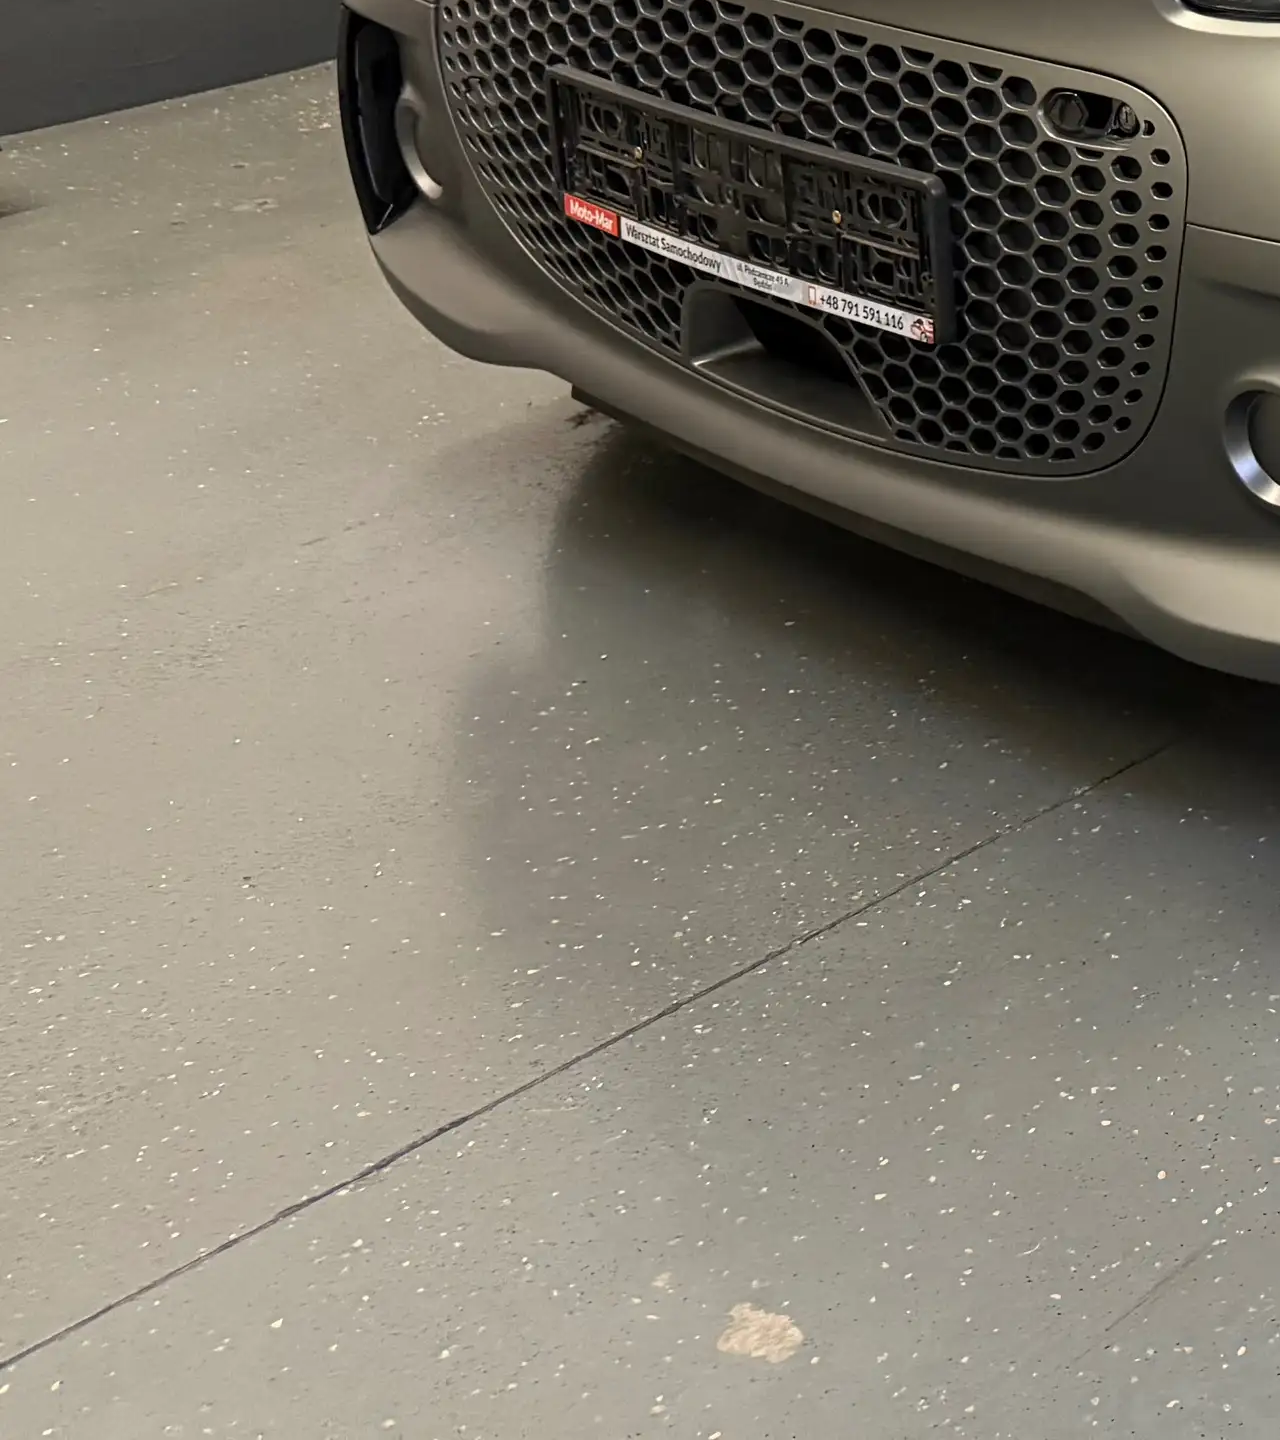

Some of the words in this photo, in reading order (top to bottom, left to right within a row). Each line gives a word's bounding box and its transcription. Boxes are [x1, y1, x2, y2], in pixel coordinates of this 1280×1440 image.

[568, 199, 614, 231] Moto-Mar
[625, 222, 661, 248] Warsztat
[661, 237, 722, 273] Samochodowy
[820, 294, 839, 311] +48
[840, 297, 860, 317] 791
[862, 305, 881, 323] 591
[884, 311, 904, 330] 116
